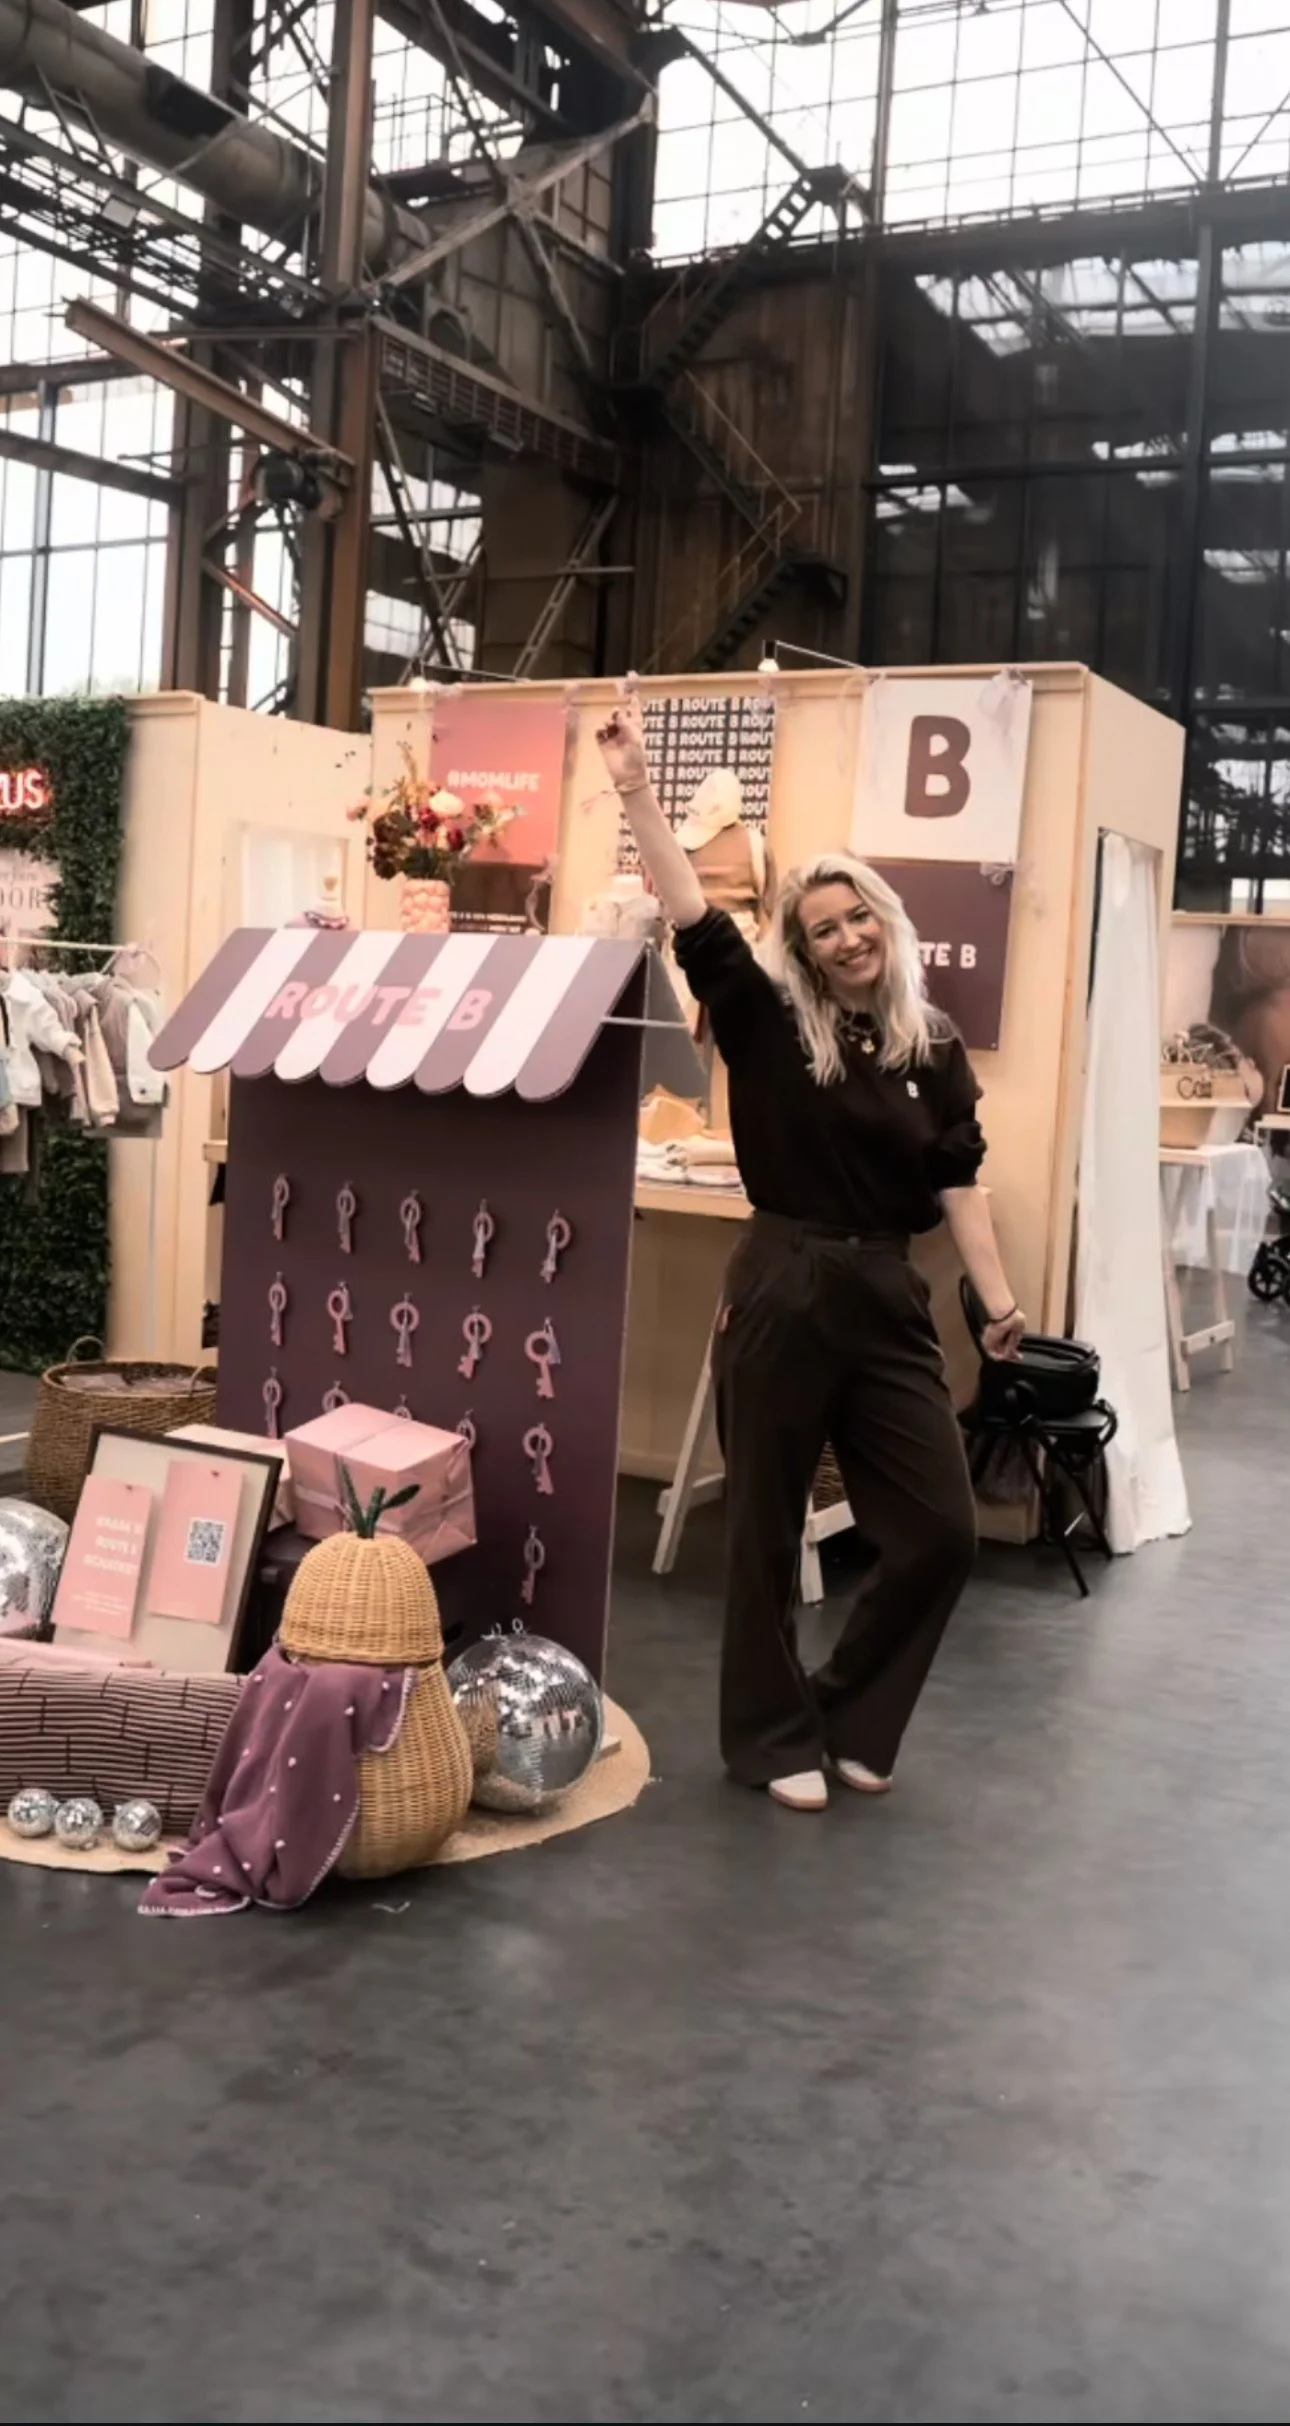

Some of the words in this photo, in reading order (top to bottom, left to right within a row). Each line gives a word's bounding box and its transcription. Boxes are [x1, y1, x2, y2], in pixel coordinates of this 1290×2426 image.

[681, 697, 726, 712] ROUTE
[680, 714, 725, 729] ROUTE
[680, 731, 724, 746] ROUTE
[678, 748, 723, 763] ROUTE
[904, 715, 971, 818] B
[960, 944, 977, 969] B
[264, 981, 442, 1027] ROUTE
[446, 988, 494, 1031] B
